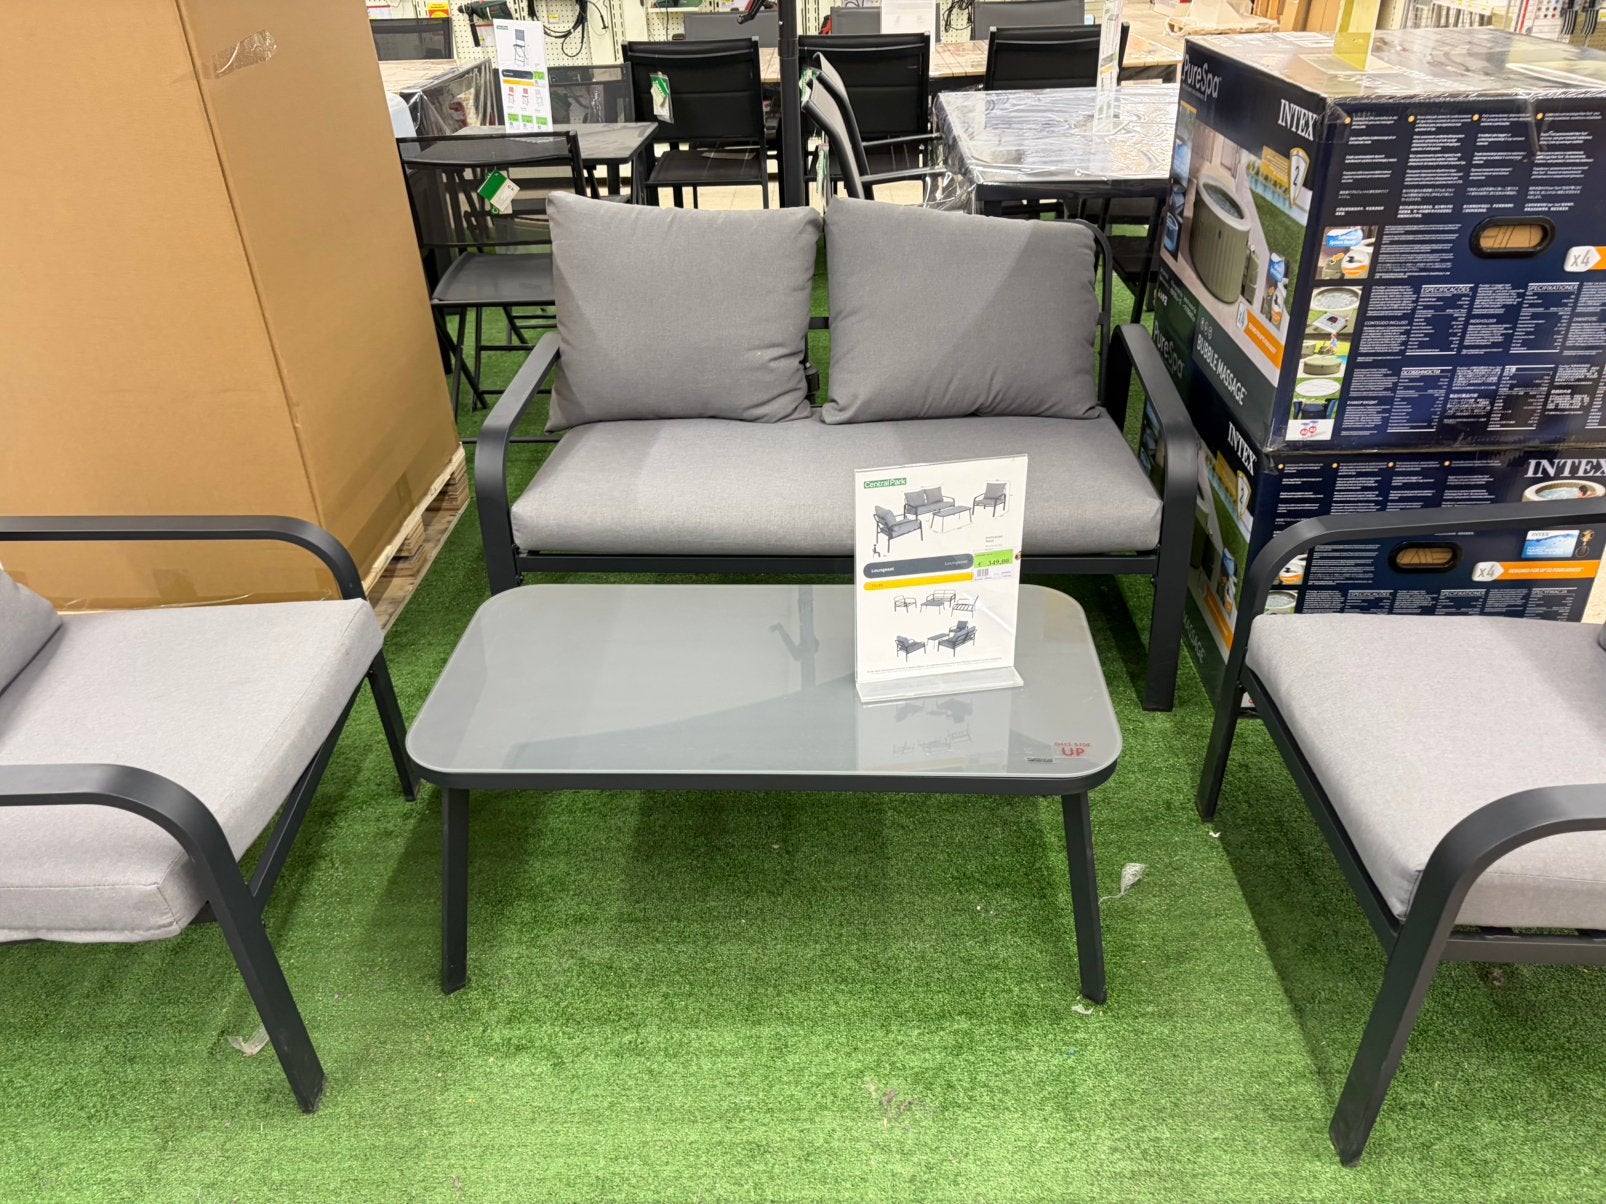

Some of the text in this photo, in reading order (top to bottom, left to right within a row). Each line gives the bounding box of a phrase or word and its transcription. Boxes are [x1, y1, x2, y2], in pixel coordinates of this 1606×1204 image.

[1181, 54, 1222, 101] PureSpa
[1277, 99, 1318, 141] INTEX
[1293, 166, 1301, 187] 2
[1196, 333, 1218, 372] BUBBLE
[1216, 358, 1244, 406] MASSAGE
[1227, 421, 1258, 477] INTEX
[864, 478, 906, 488] Central Park
[1062, 747, 1085, 757] UP
